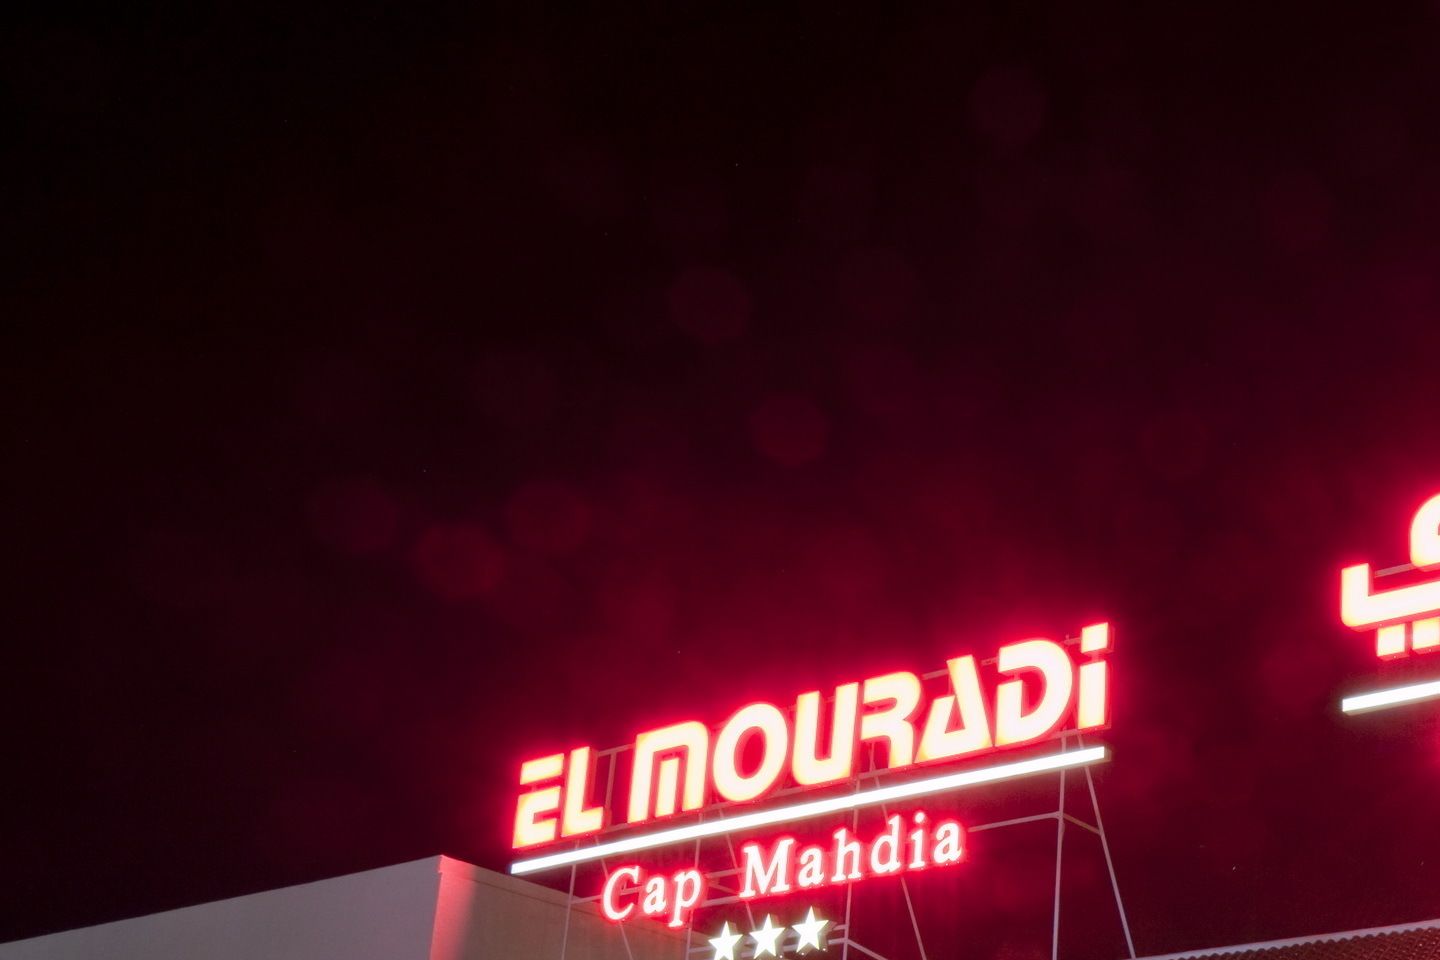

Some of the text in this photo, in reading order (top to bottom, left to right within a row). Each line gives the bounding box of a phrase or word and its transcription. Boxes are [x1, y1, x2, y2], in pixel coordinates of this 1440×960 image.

[510, 745, 606, 849] EL
[600, 809, 964, 928] Cap Mahdia
